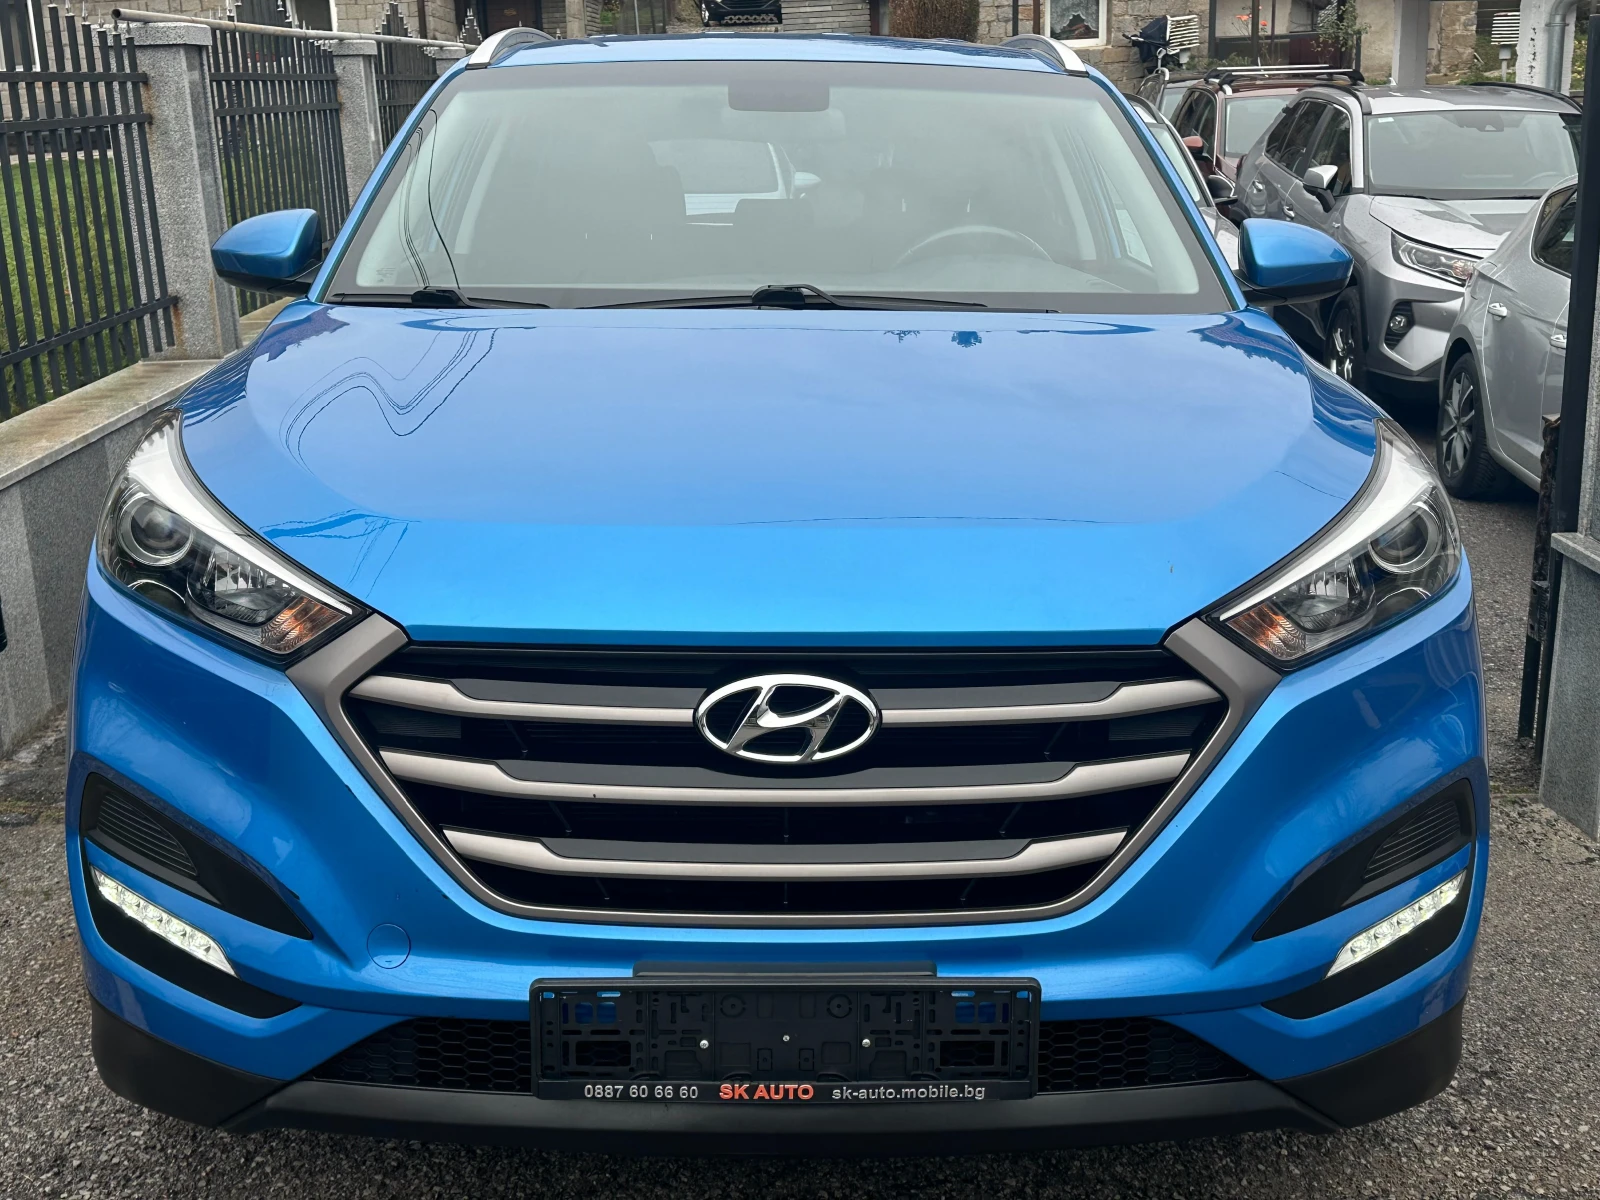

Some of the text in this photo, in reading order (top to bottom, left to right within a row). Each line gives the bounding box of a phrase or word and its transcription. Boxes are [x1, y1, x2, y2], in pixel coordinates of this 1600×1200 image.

[584, 1083, 986, 1100] 0887 60 66 60 SK AUTO sk-auto.mobile.bg
